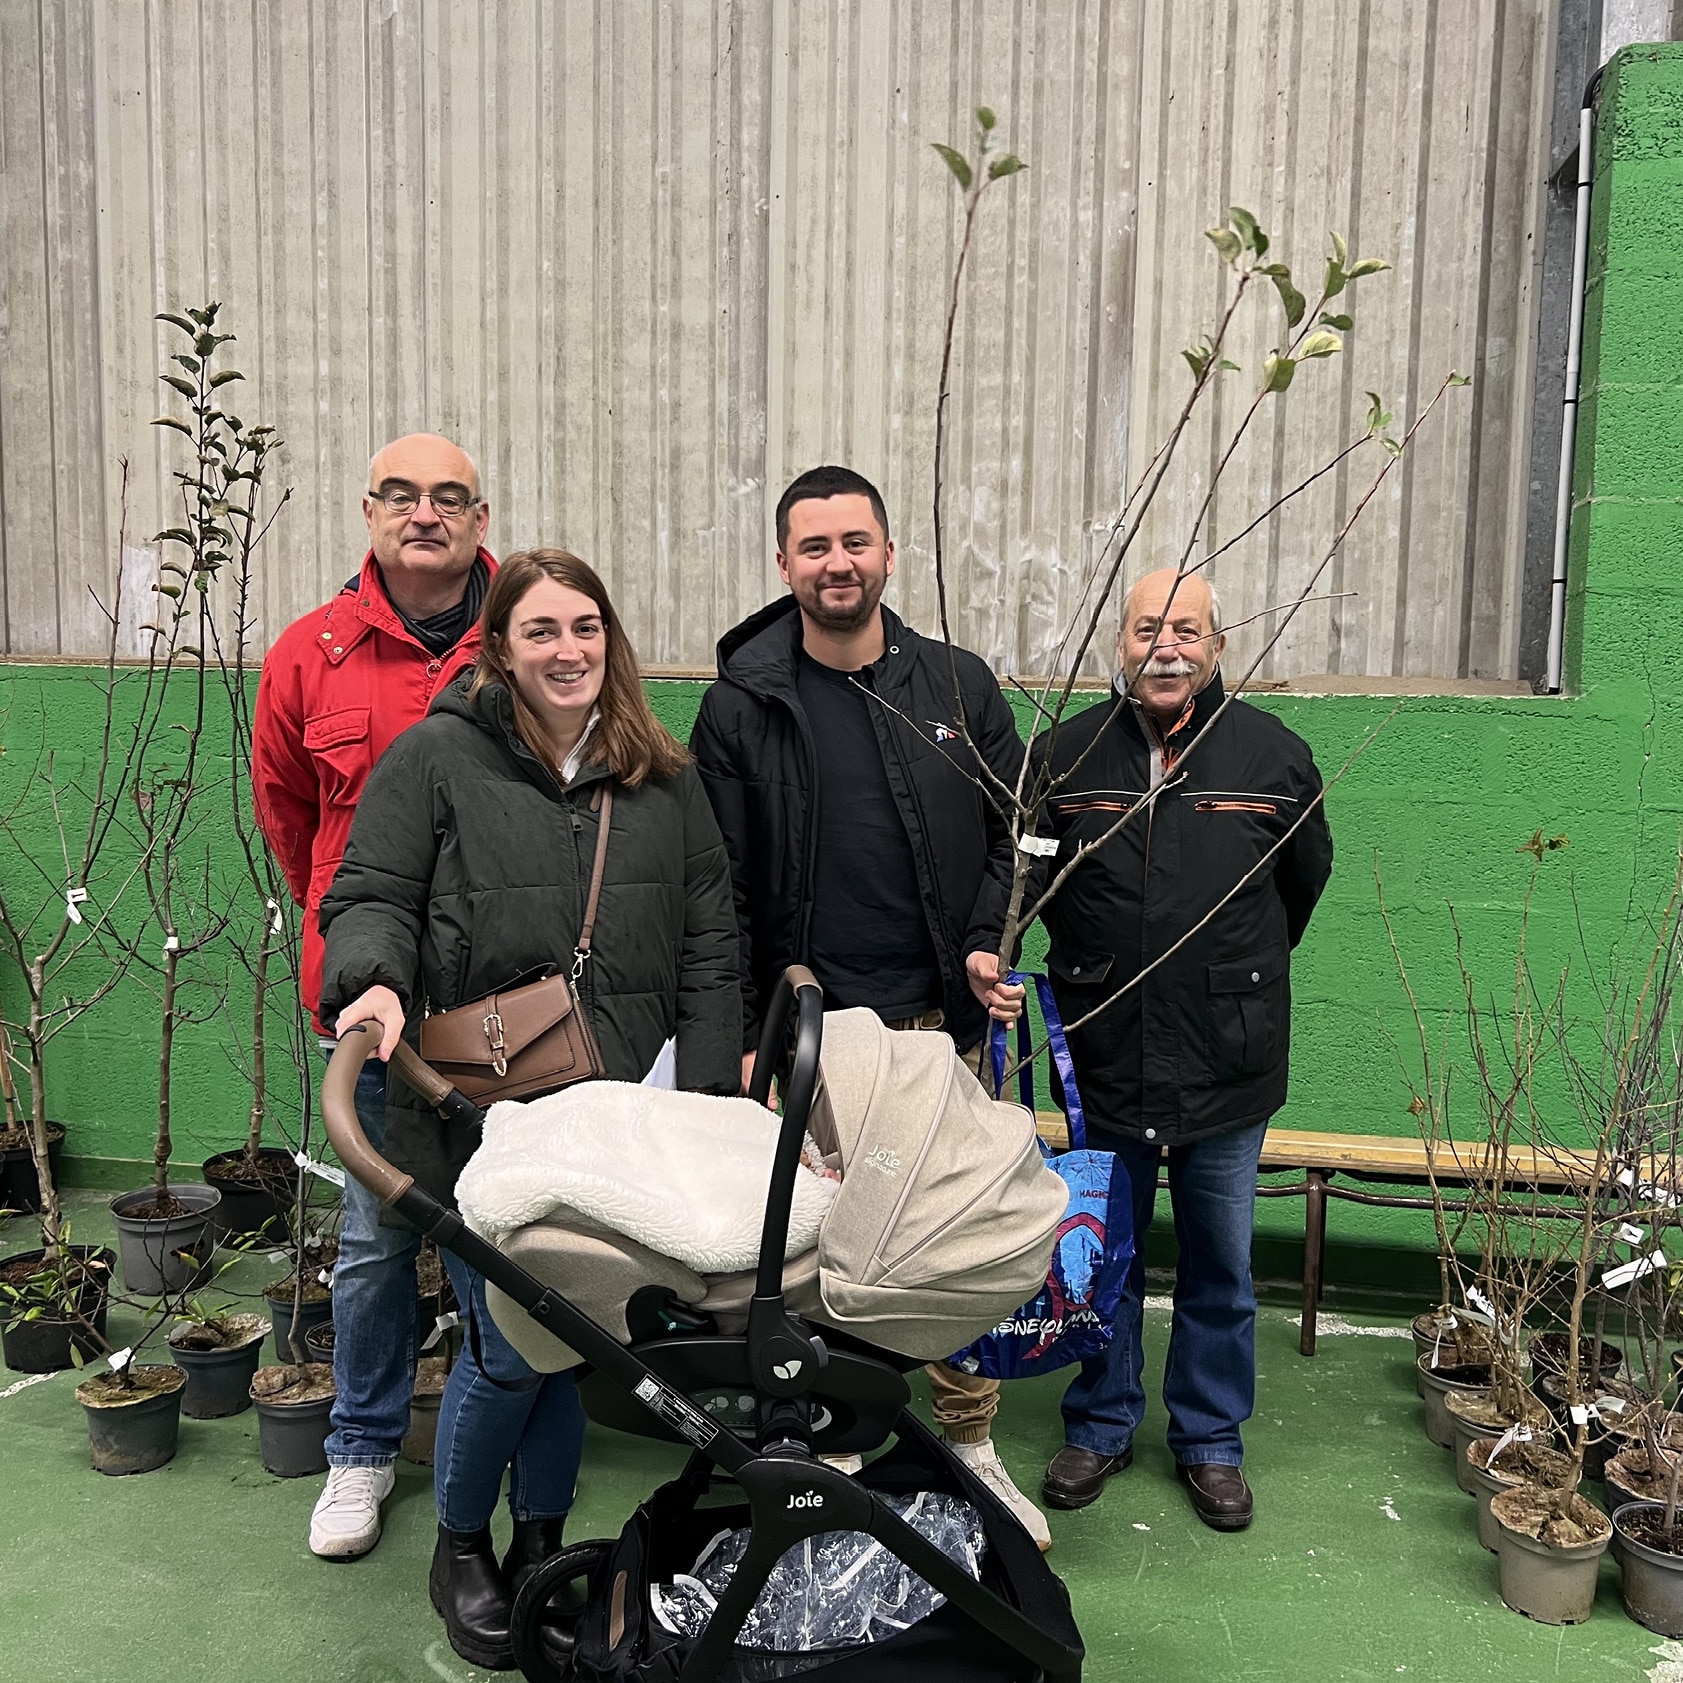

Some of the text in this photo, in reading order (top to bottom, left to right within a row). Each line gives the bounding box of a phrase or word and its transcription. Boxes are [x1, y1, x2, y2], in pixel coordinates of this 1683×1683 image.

[868, 1144, 901, 1169] Joie
[992, 1308, 1100, 1346] SNEYLAND
[786, 1490, 824, 1509] Joie
